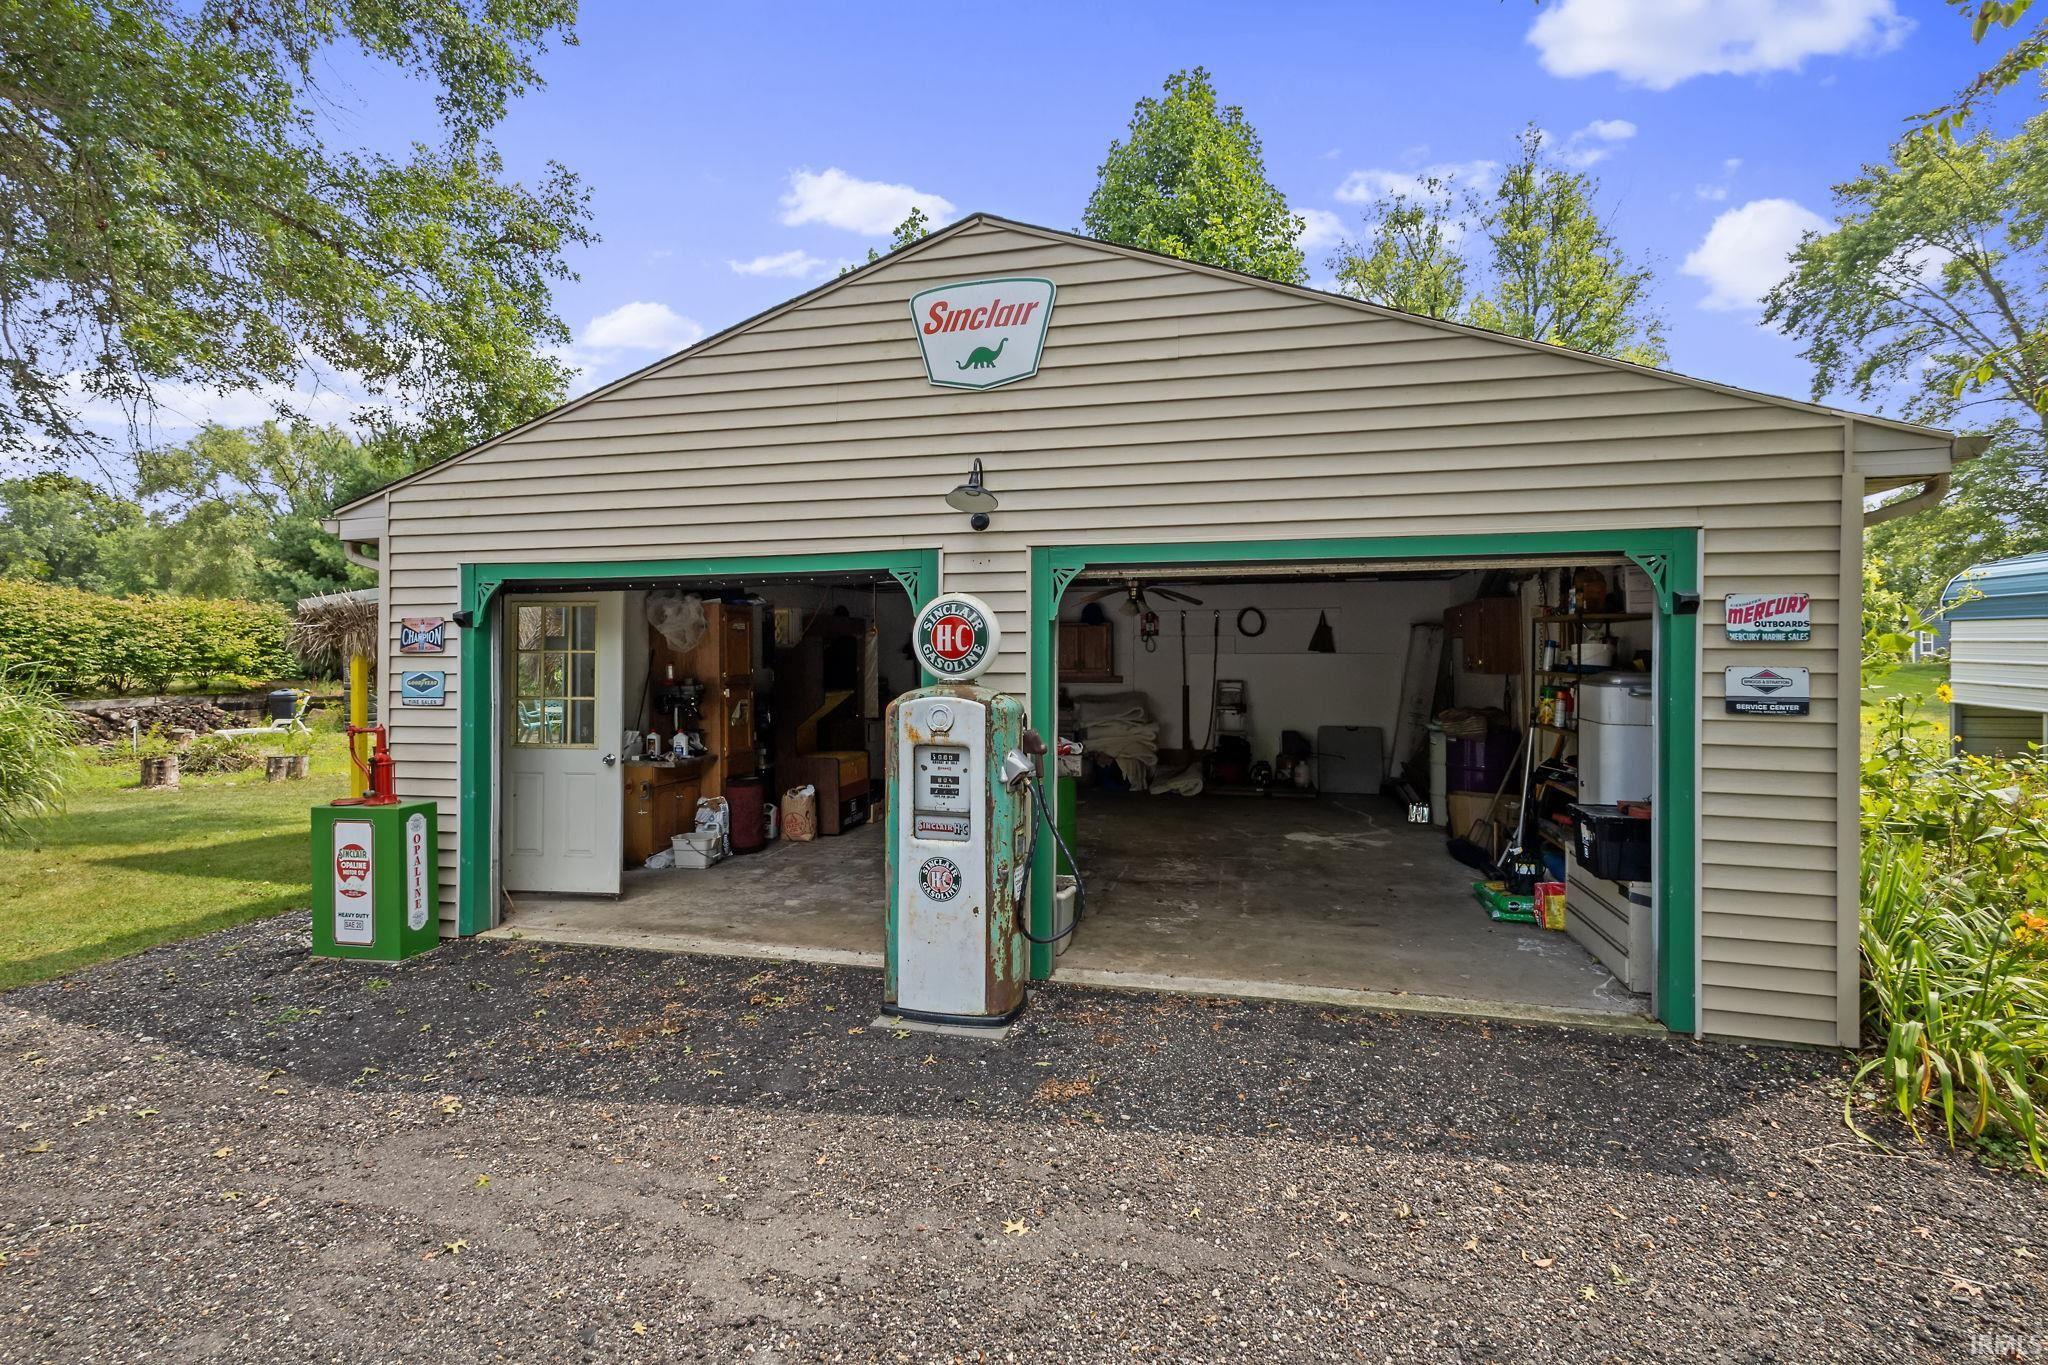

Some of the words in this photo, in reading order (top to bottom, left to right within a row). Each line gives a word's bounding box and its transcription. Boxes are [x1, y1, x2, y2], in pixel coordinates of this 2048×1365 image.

[924, 299, 1040, 335] Sinclair
[923, 604, 984, 631] SINCLAIR
[1727, 596, 1809, 625] MERCURY
[1754, 620, 1810, 628] OUTBOARDS
[1729, 632, 1760, 641] MERCURY
[1761, 632, 1786, 641] MARINE
[1787, 632, 1809, 641] SALES
[922, 644, 985, 671] GASOLINE
[1735, 703, 1768, 711] SERVICE
[918, 820, 954, 832] SINCLAIR
[338, 848, 368, 860] SINCLAIR
[340, 861, 367, 870] OPALINE
[413, 833, 422, 910] OPALINE
[922, 859, 958, 877] SINCLAIR
[922, 882, 959, 900] GASOLINE
